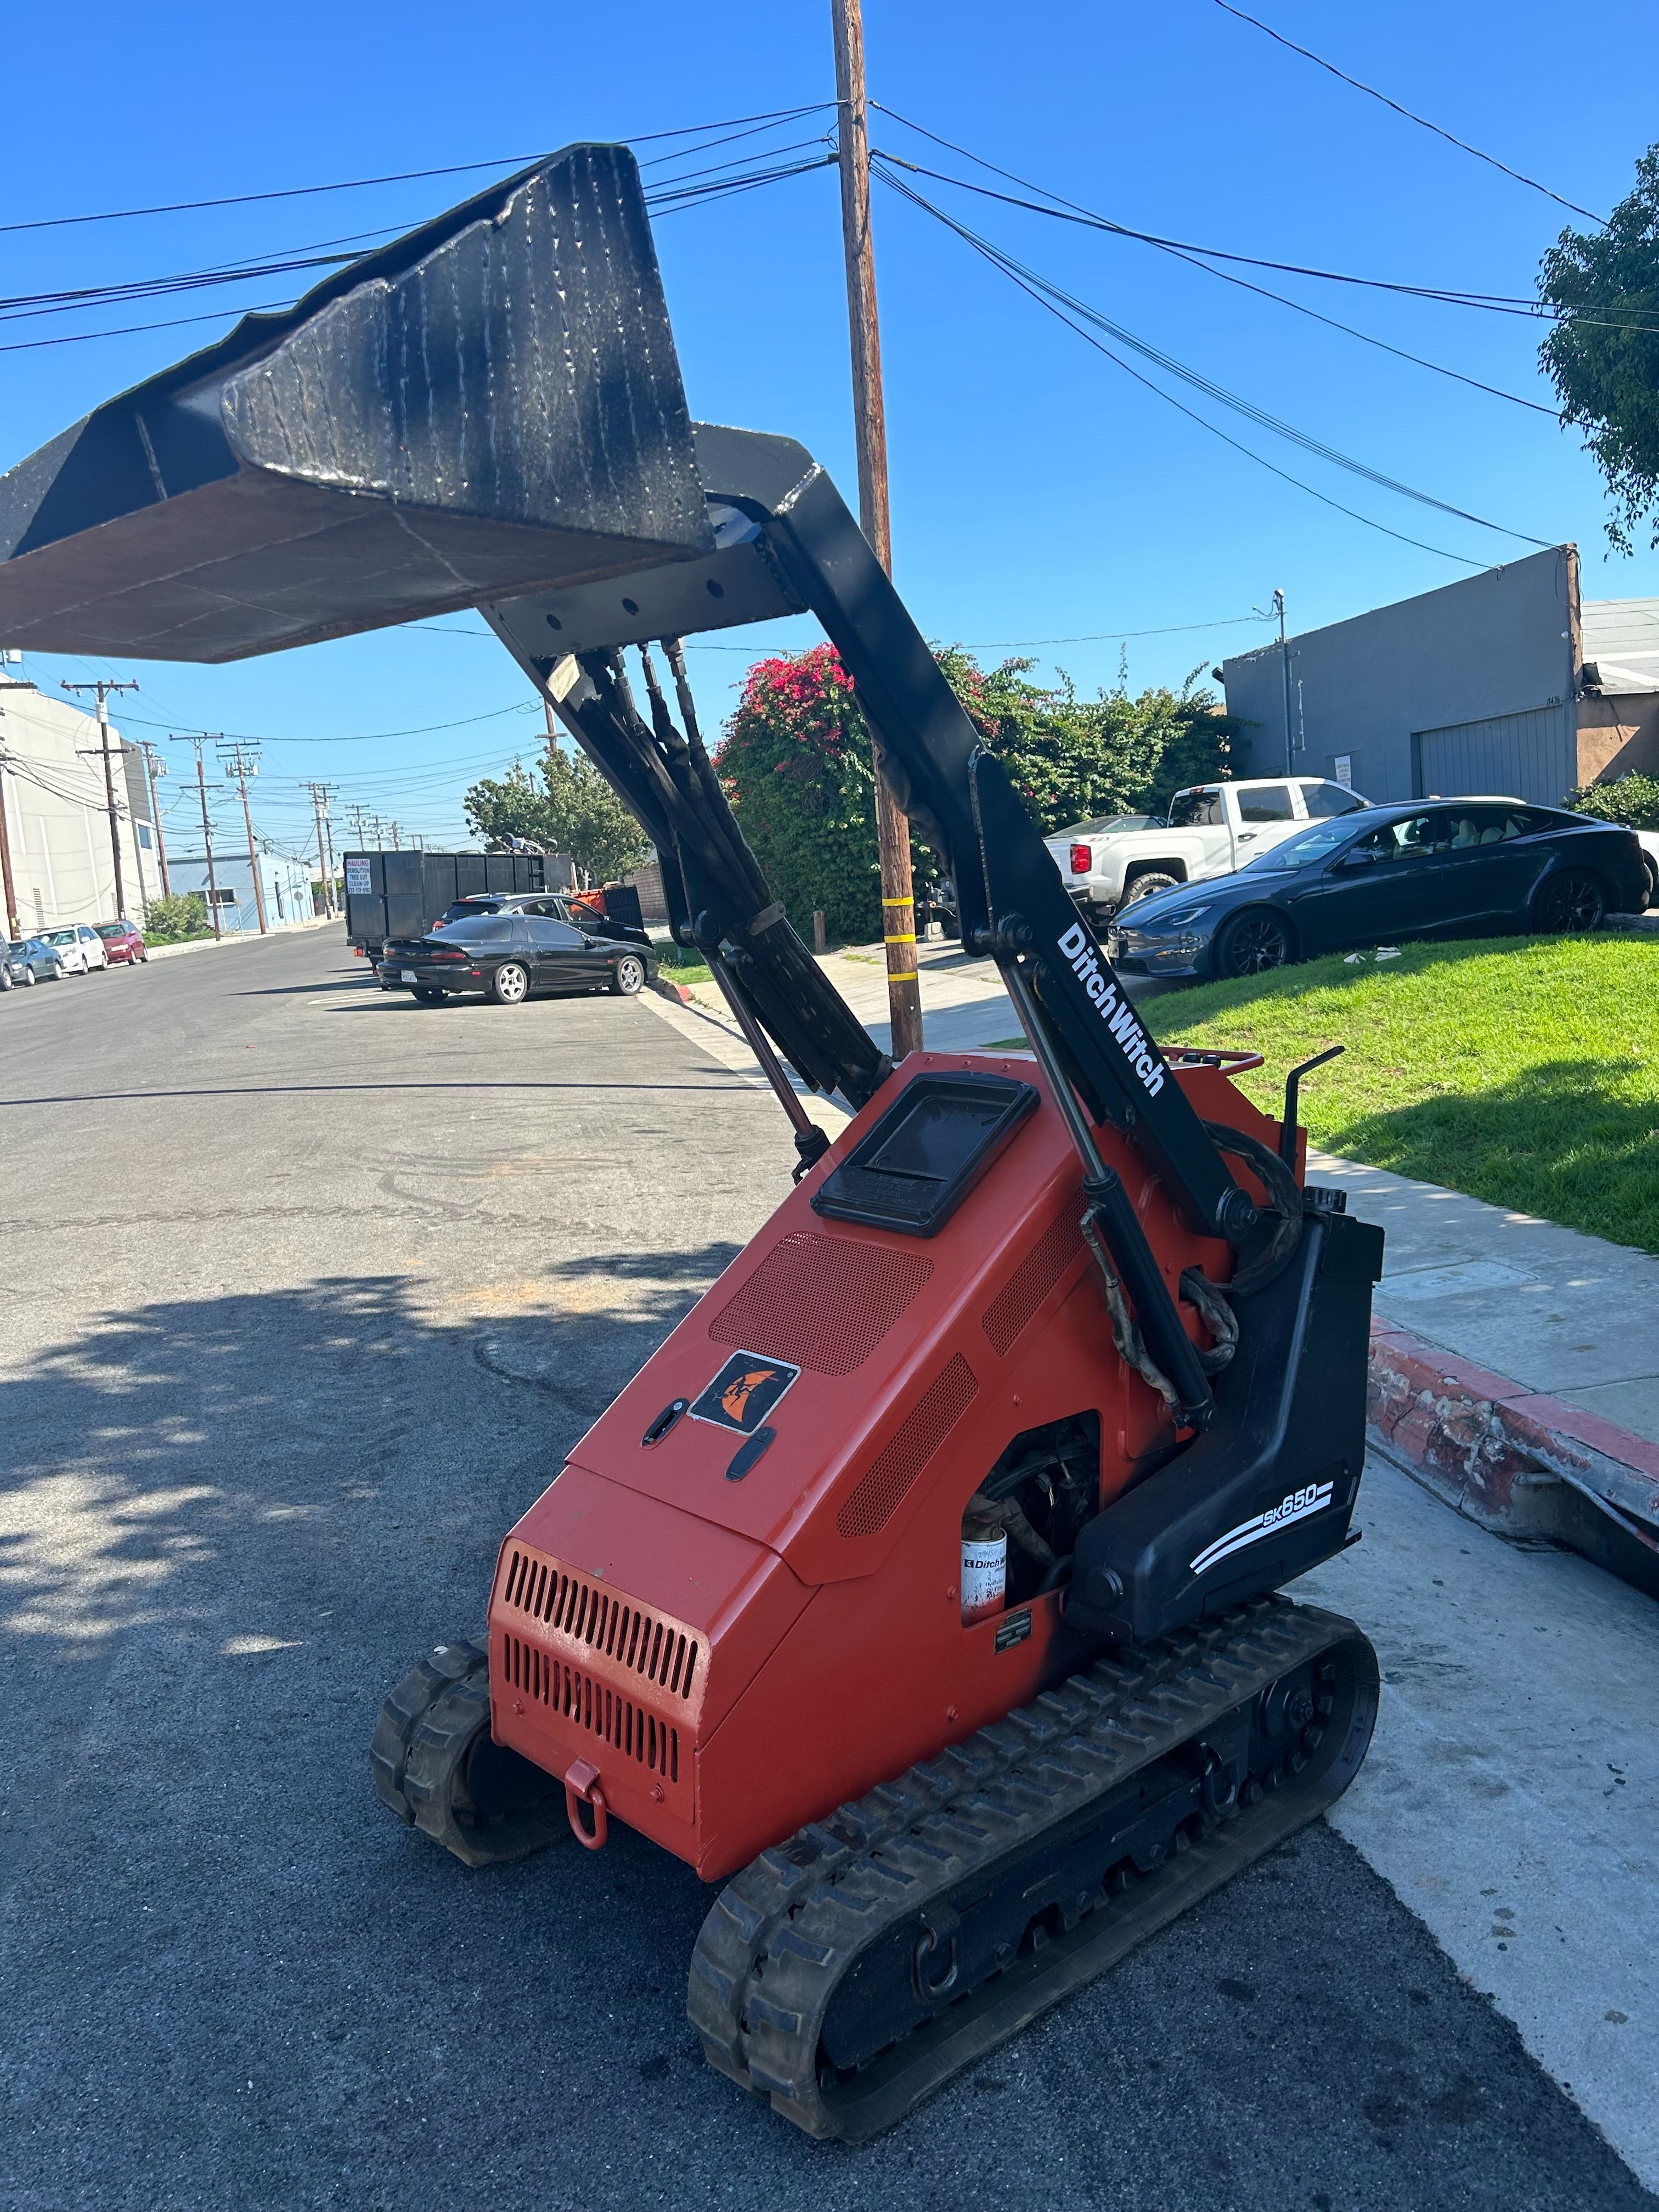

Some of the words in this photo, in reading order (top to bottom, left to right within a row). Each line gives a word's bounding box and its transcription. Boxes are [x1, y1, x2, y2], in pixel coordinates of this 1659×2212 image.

[1057, 922, 1117, 1019] Ditch
[1108, 1001, 1164, 1097] Witch
[1263, 1483, 1317, 1526] SK650
[975, 1558, 1000, 1568] Ditch
